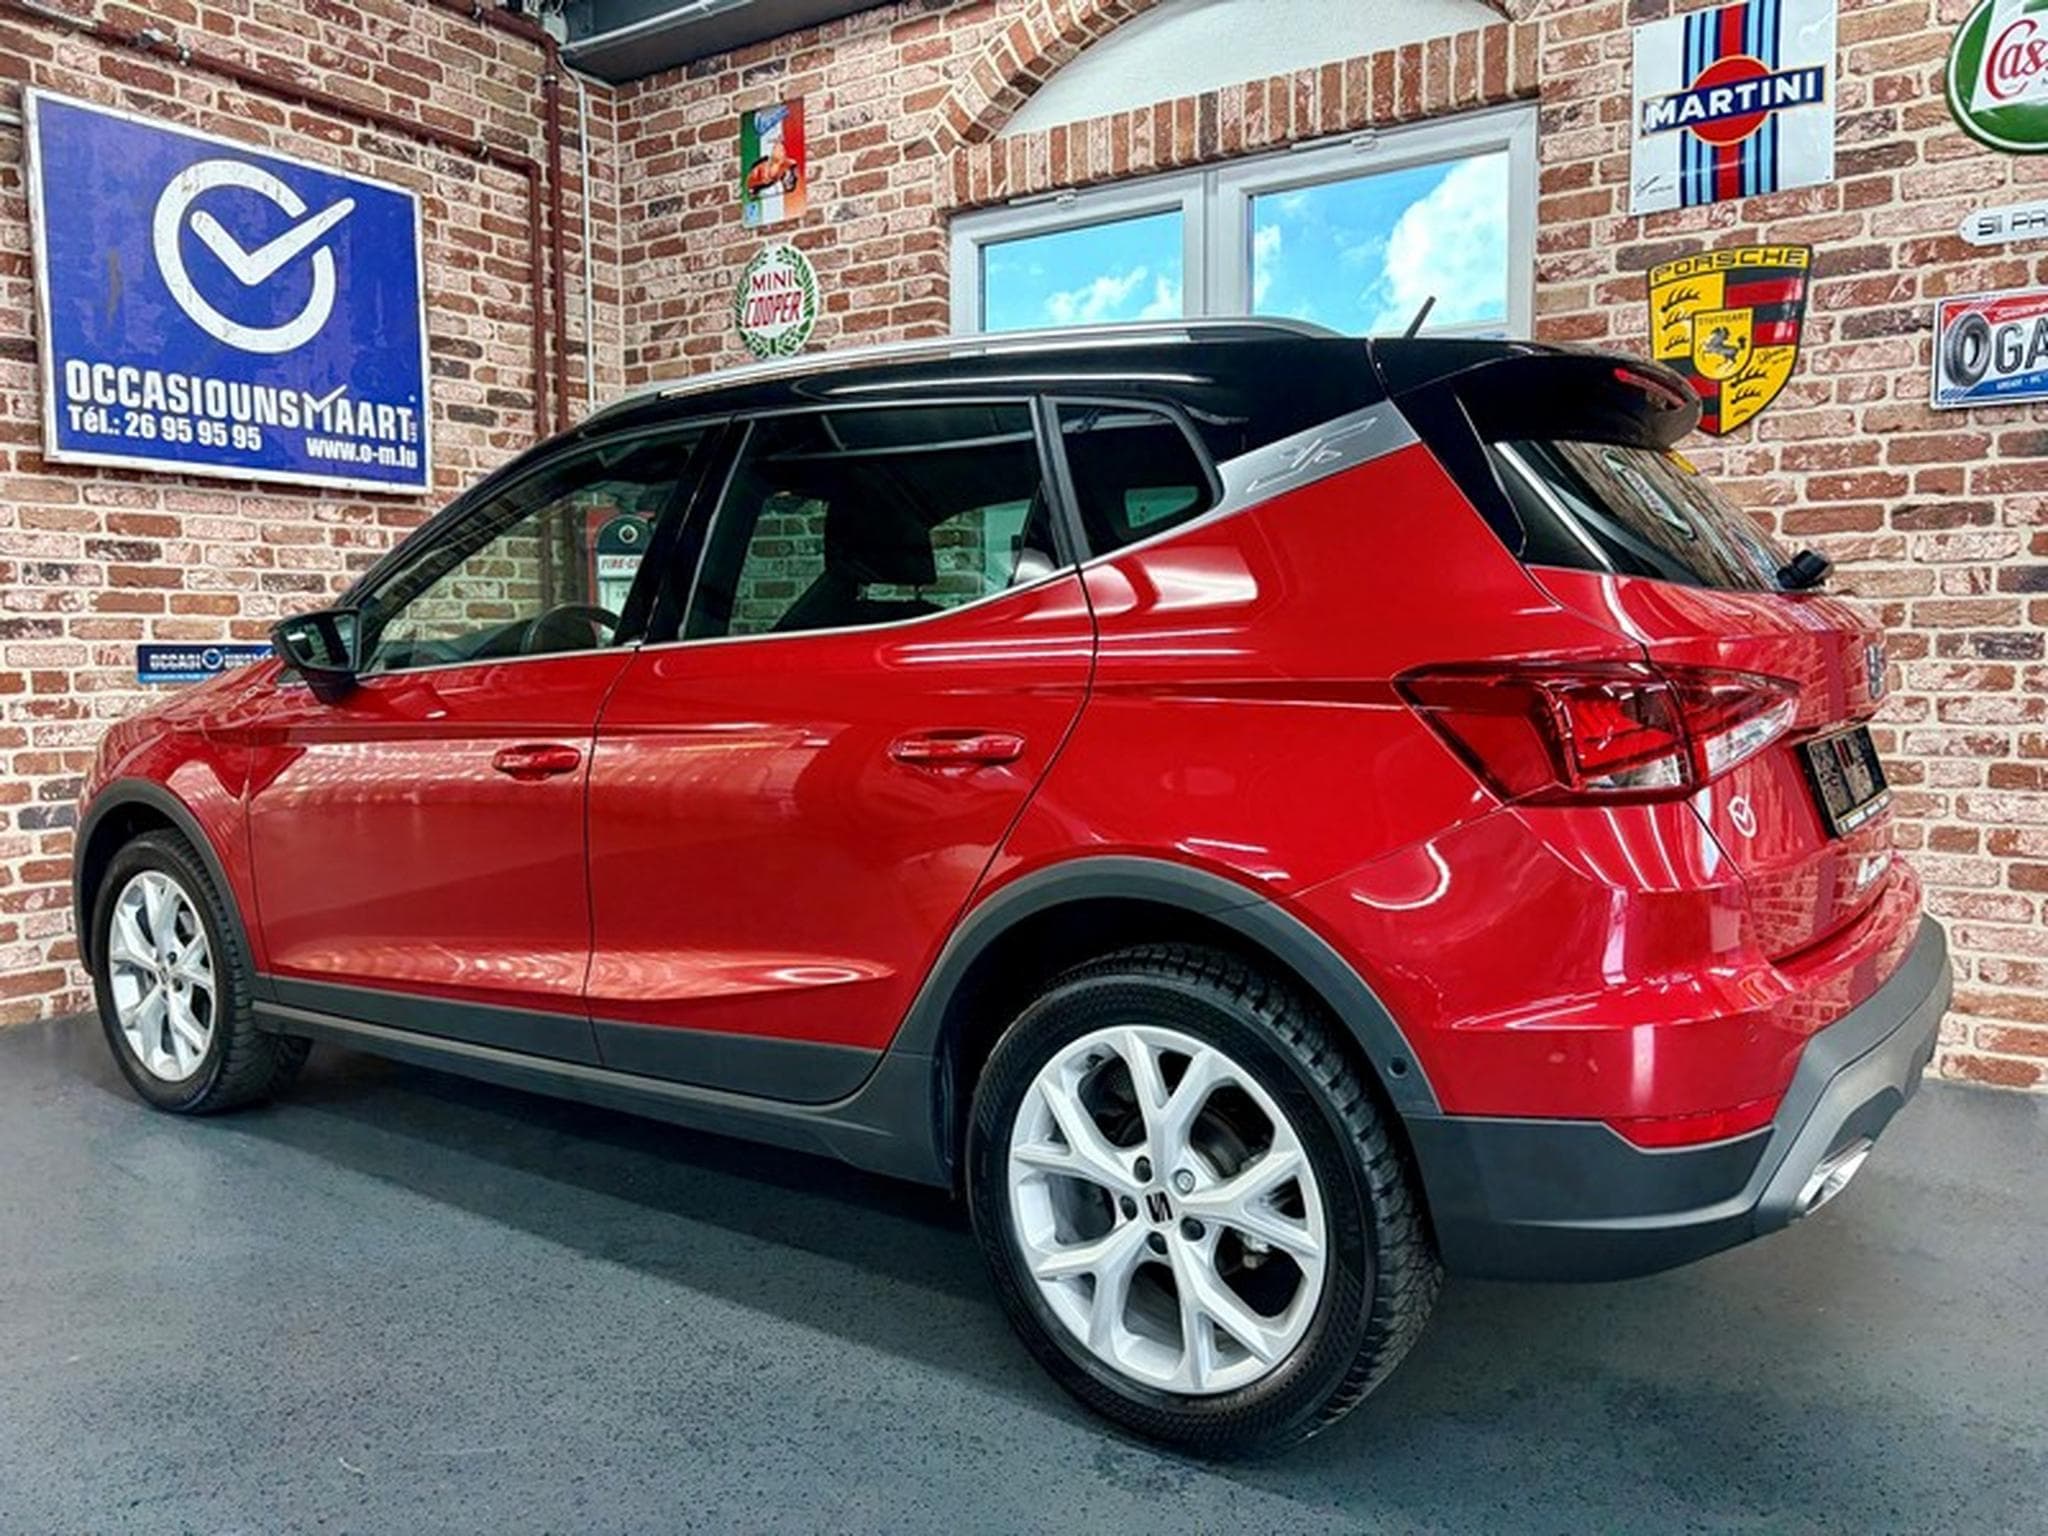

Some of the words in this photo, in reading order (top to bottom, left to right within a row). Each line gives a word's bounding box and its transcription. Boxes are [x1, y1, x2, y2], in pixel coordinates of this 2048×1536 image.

[1986, 19, 2048, 99] Cas
[1645, 72, 1815, 130] MARTINI
[752, 269, 793, 293] MINI
[1653, 250, 1805, 283] PORSCHE
[744, 291, 802, 328] COOPER
[125, 411, 156, 439] 26
[161, 415, 193, 443] 95
[198, 420, 228, 447] 95
[232, 424, 262, 451] 95
[306, 437, 418, 469] www.o-m.lu
